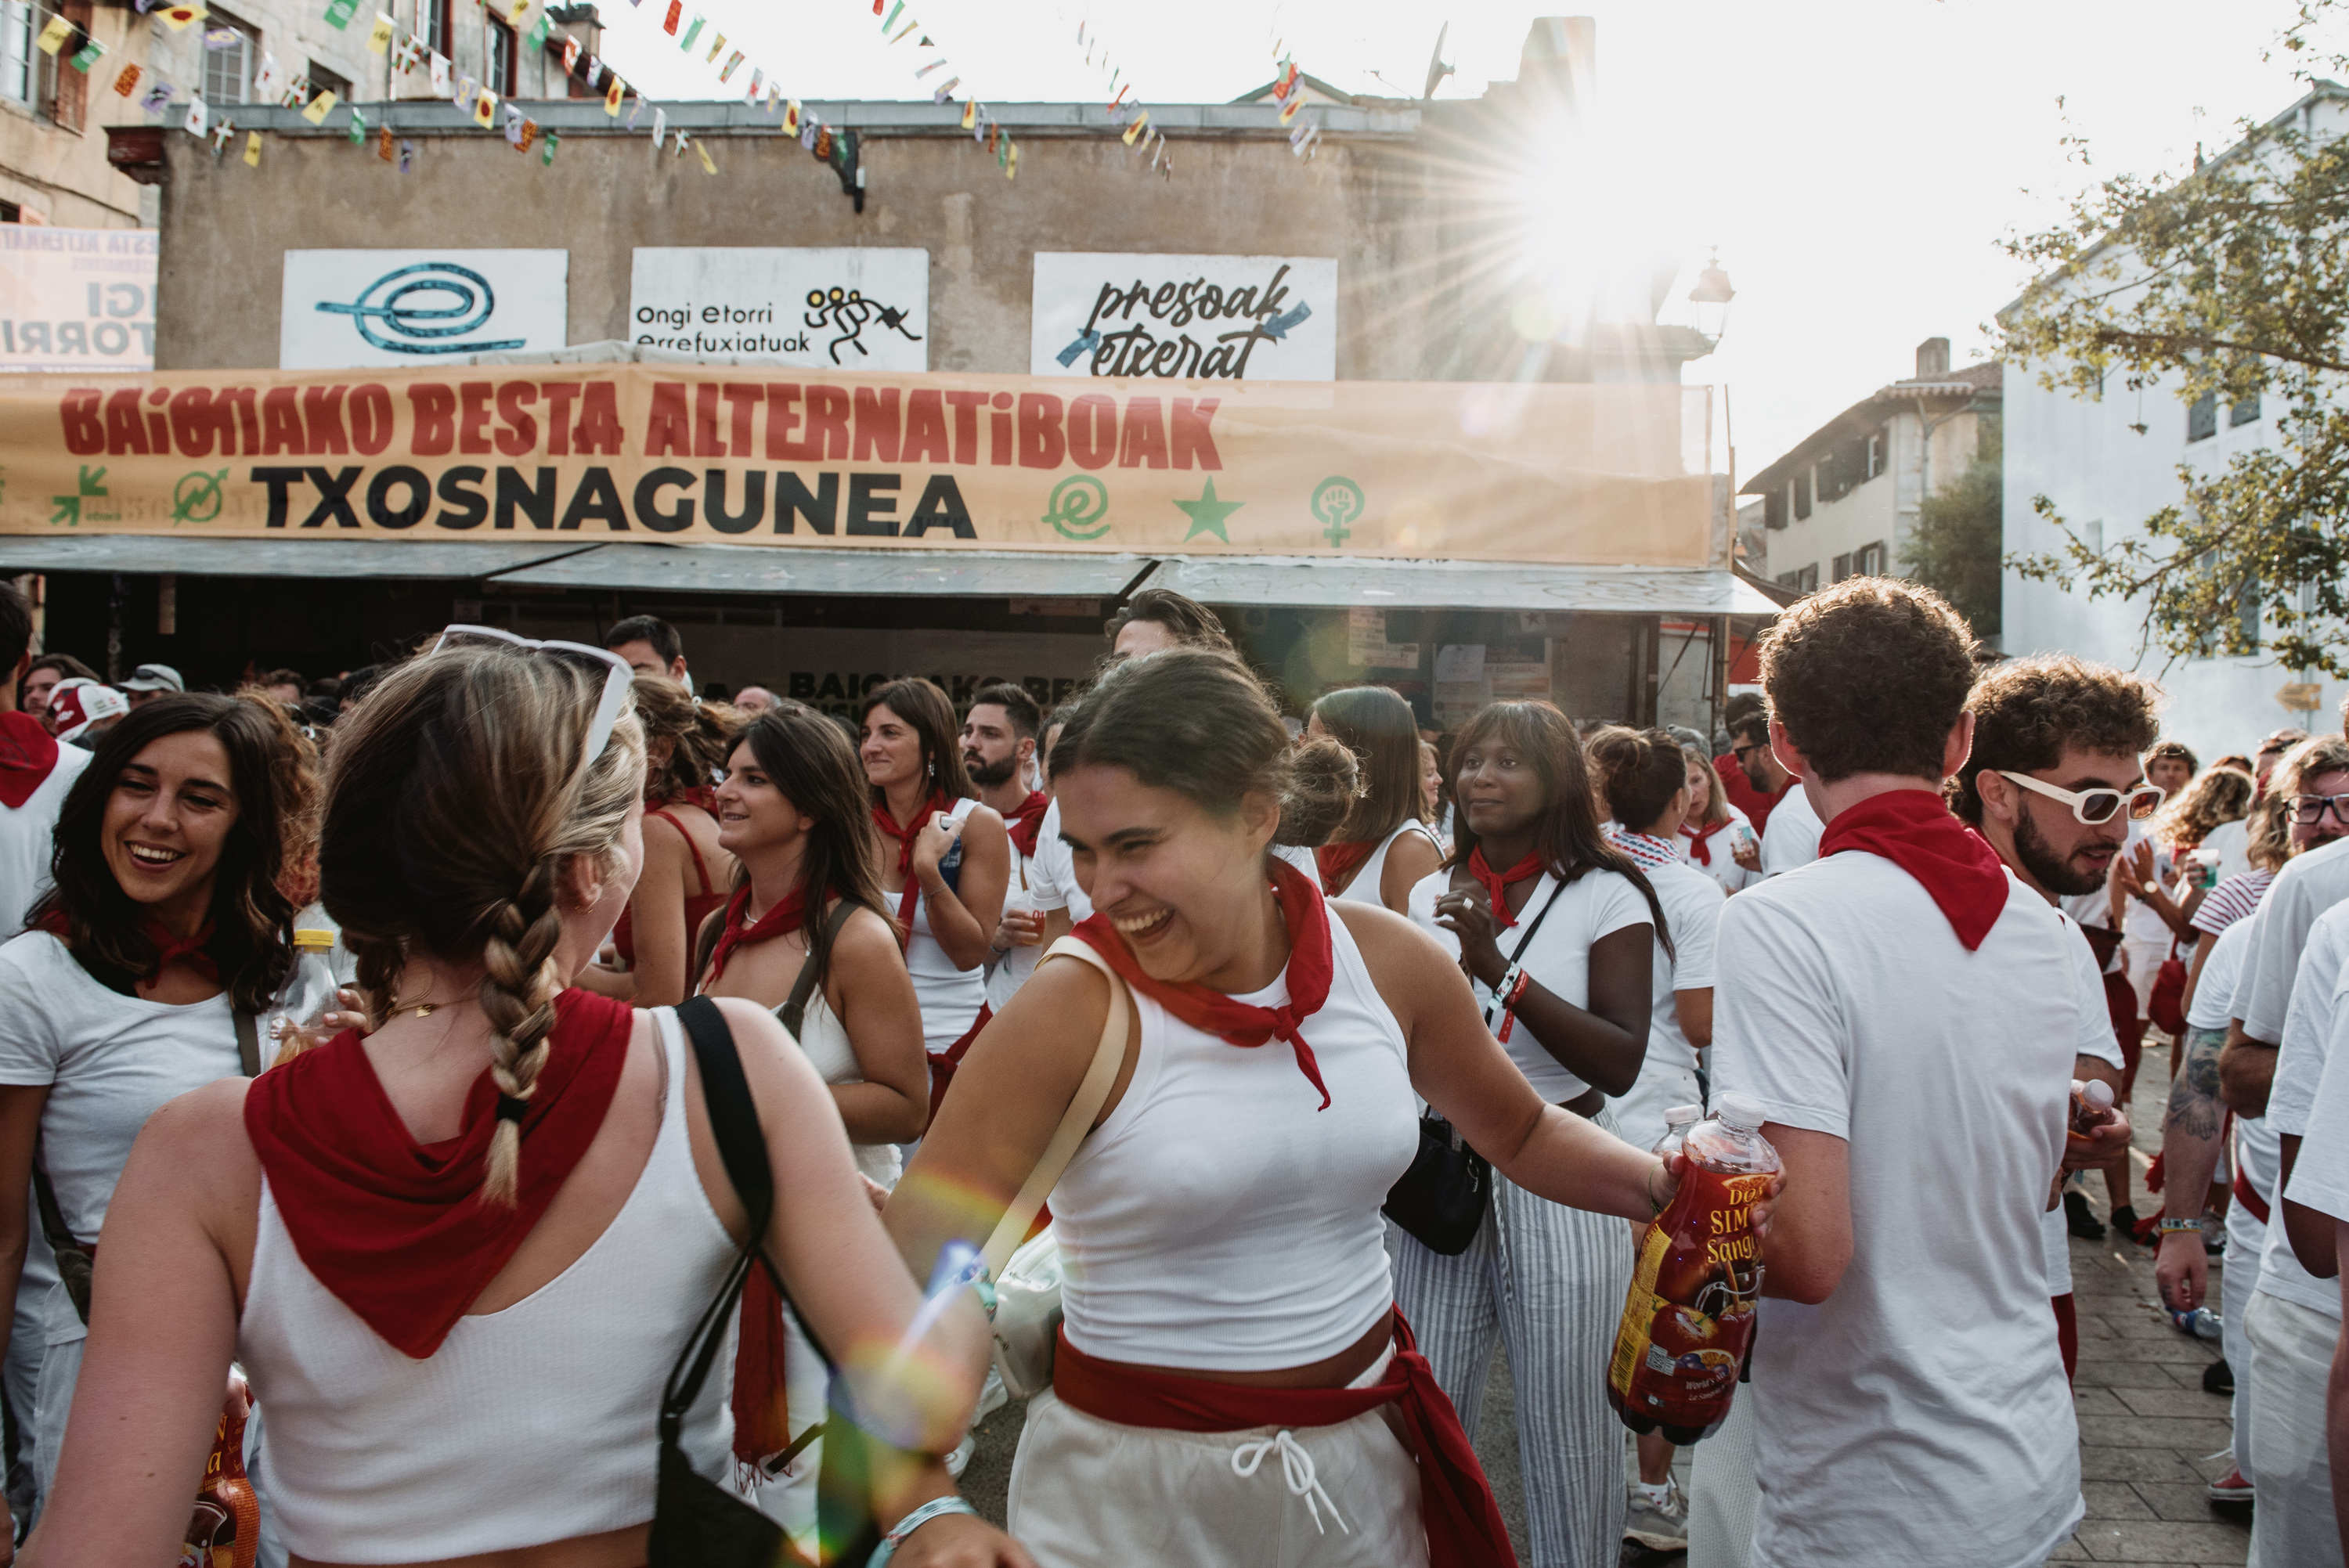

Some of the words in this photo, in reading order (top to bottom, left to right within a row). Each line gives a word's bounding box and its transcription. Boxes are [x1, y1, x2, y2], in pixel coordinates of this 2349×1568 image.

[1083, 264, 1291, 338] presoak
[1090, 323, 1278, 380] etxerat
[406, 380, 624, 457] BESTA
[250, 465, 978, 540] TXOSNAGUNEA
